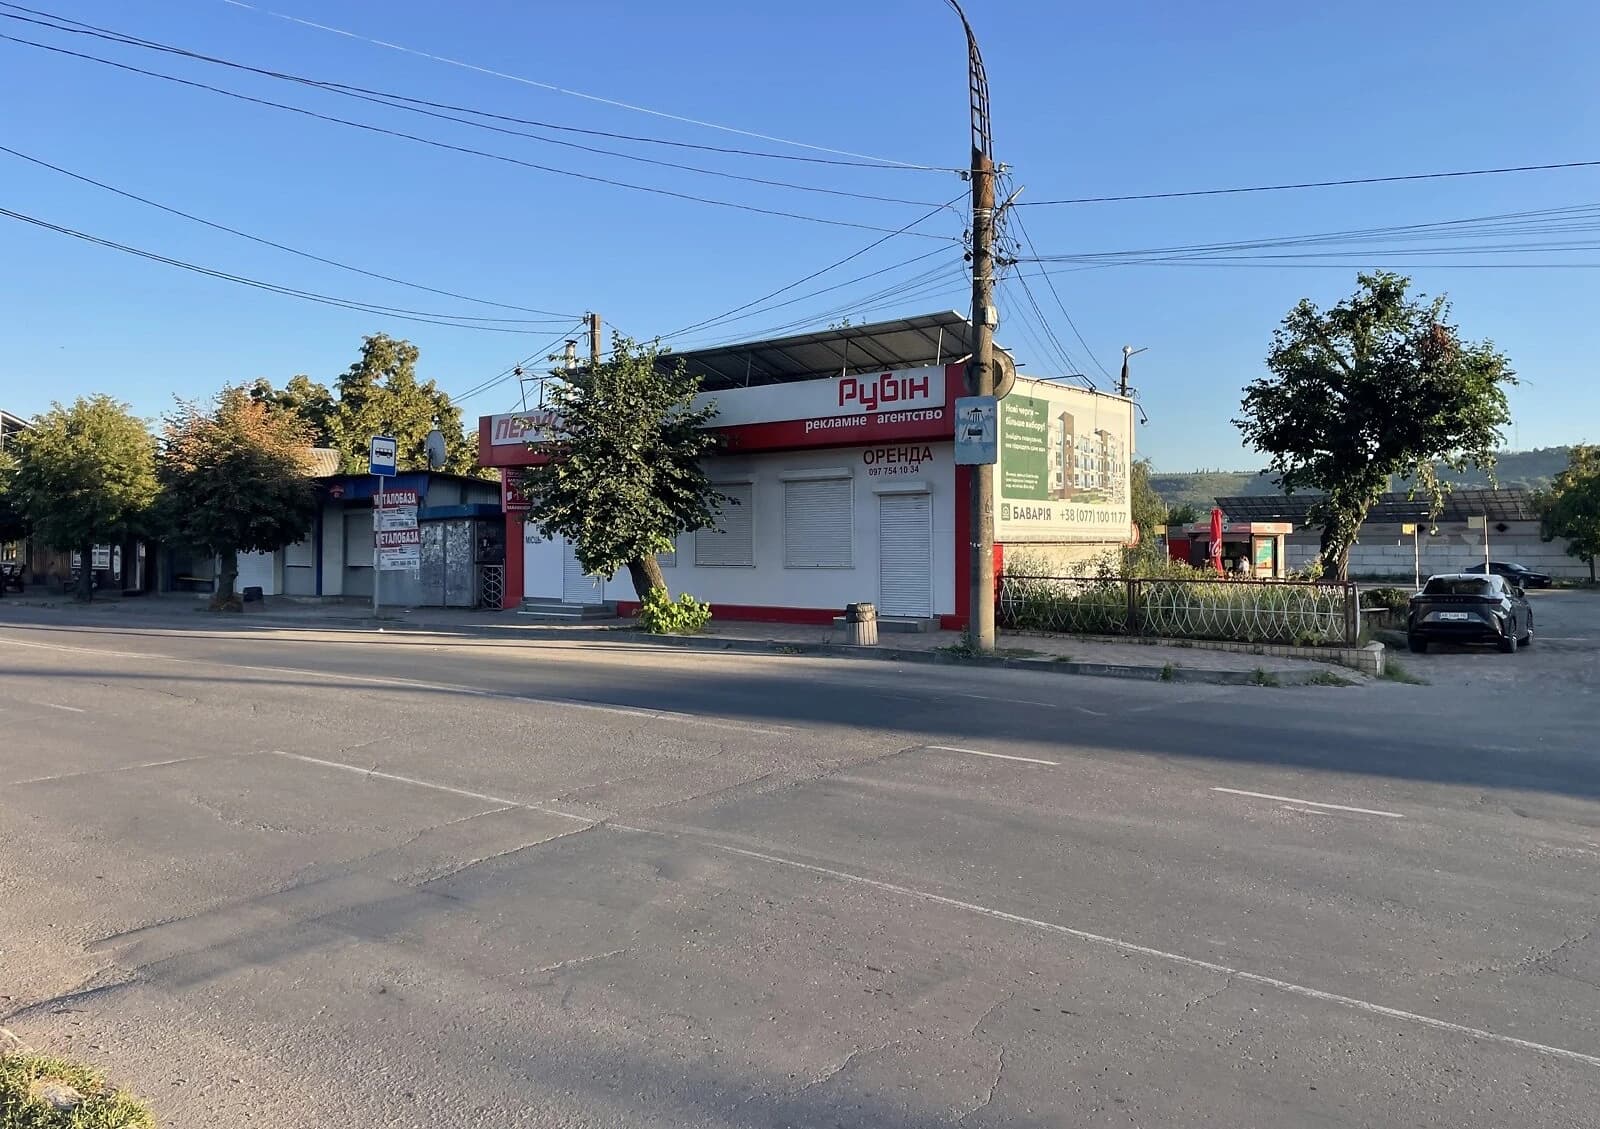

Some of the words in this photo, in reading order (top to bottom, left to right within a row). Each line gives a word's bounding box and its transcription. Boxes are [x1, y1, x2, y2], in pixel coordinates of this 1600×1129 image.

[839, 373, 928, 411] Рубін
[805, 415, 867, 433] рекламне
[877, 409, 943, 424] агентство
[863, 446, 933, 465] ОРЕНДА
[868, 467, 882, 476] 097
[884, 466, 897, 475] 754
[900, 466, 908, 474] 10
[910, 465, 919, 473] 34
[373, 492, 417, 506] МТАЛОБАЗА
[1013, 506, 1052, 520] БАВАРІЯ
[1060, 509, 1075, 521] +38
[1076, 508, 1095, 524] (077)
[1097, 511, 1109, 523] 100
[1110, 511, 1117, 523] 11
[1118, 512, 1127, 523] 77
